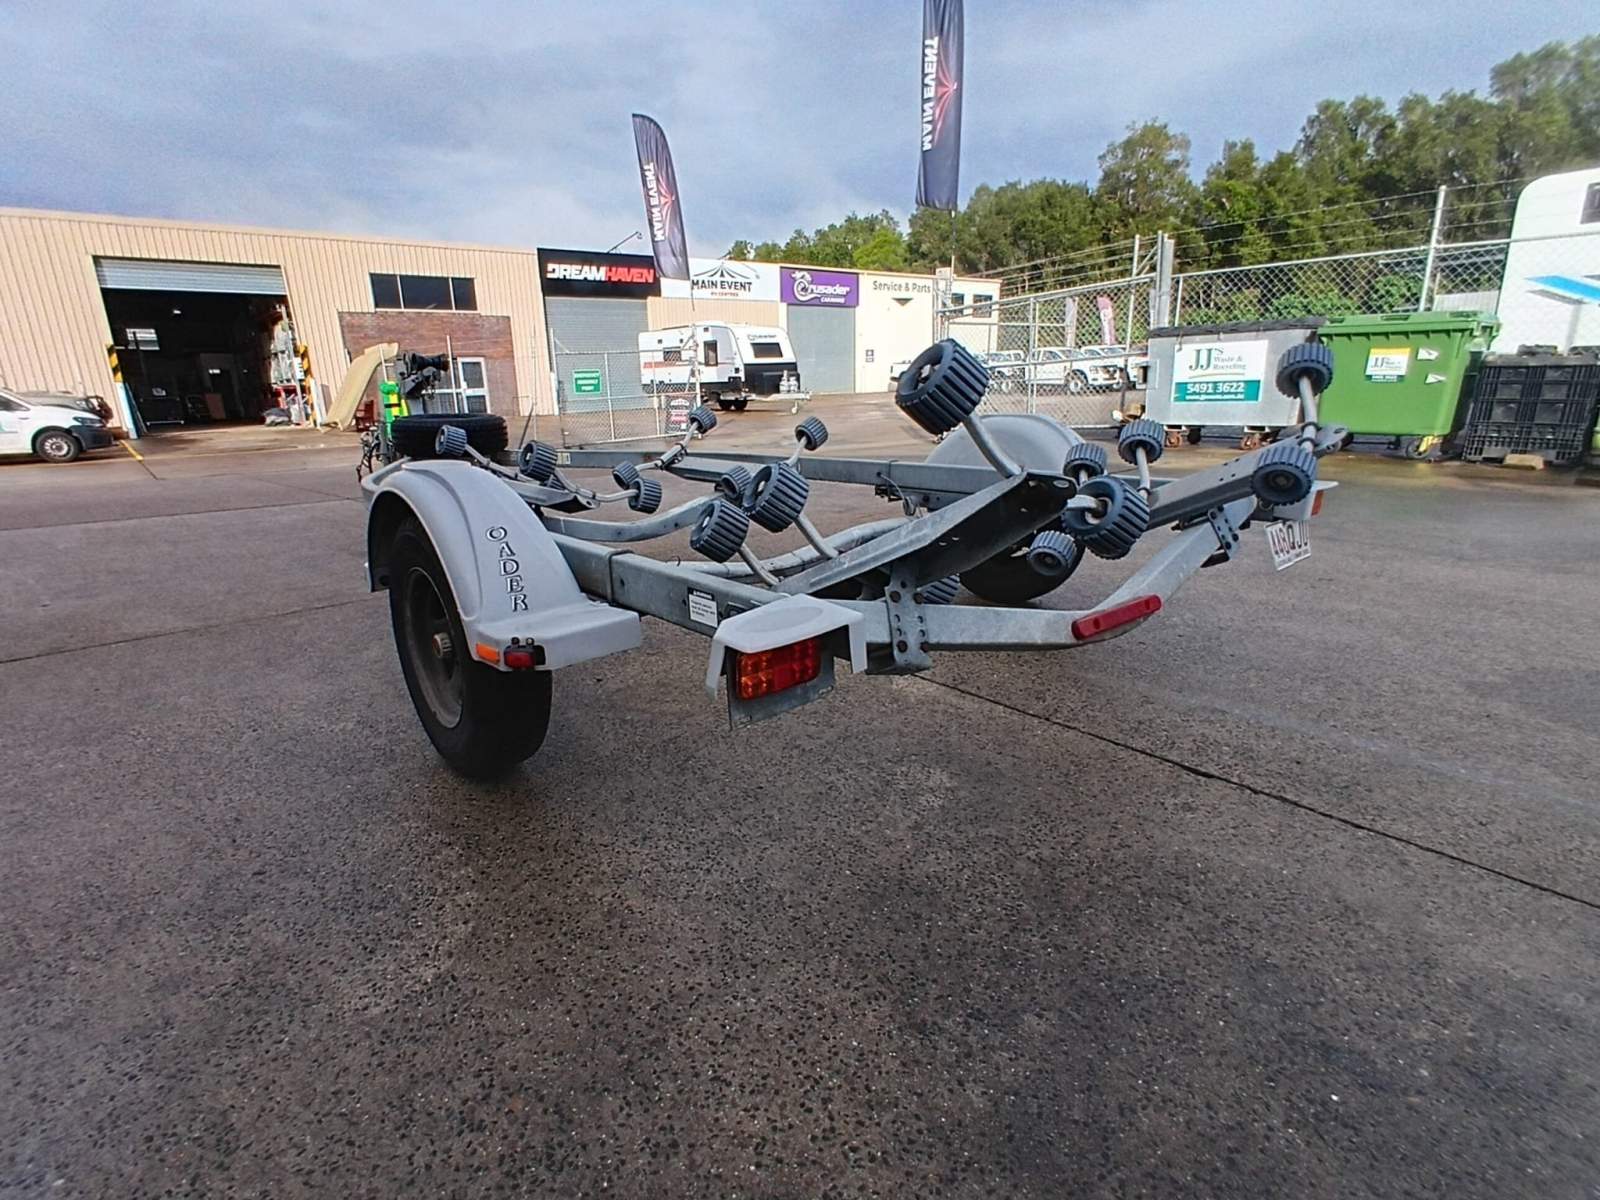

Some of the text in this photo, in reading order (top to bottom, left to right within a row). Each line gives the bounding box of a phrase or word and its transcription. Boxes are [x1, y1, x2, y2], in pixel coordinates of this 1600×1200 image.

[691, 279, 752, 292] MAIN EVENT
[793, 279, 850, 301] Crusader
[873, 280, 931, 293] Service & Parts
[1186, 382, 1245, 394] 5491 3622
[486, 527, 528, 612] OADER
